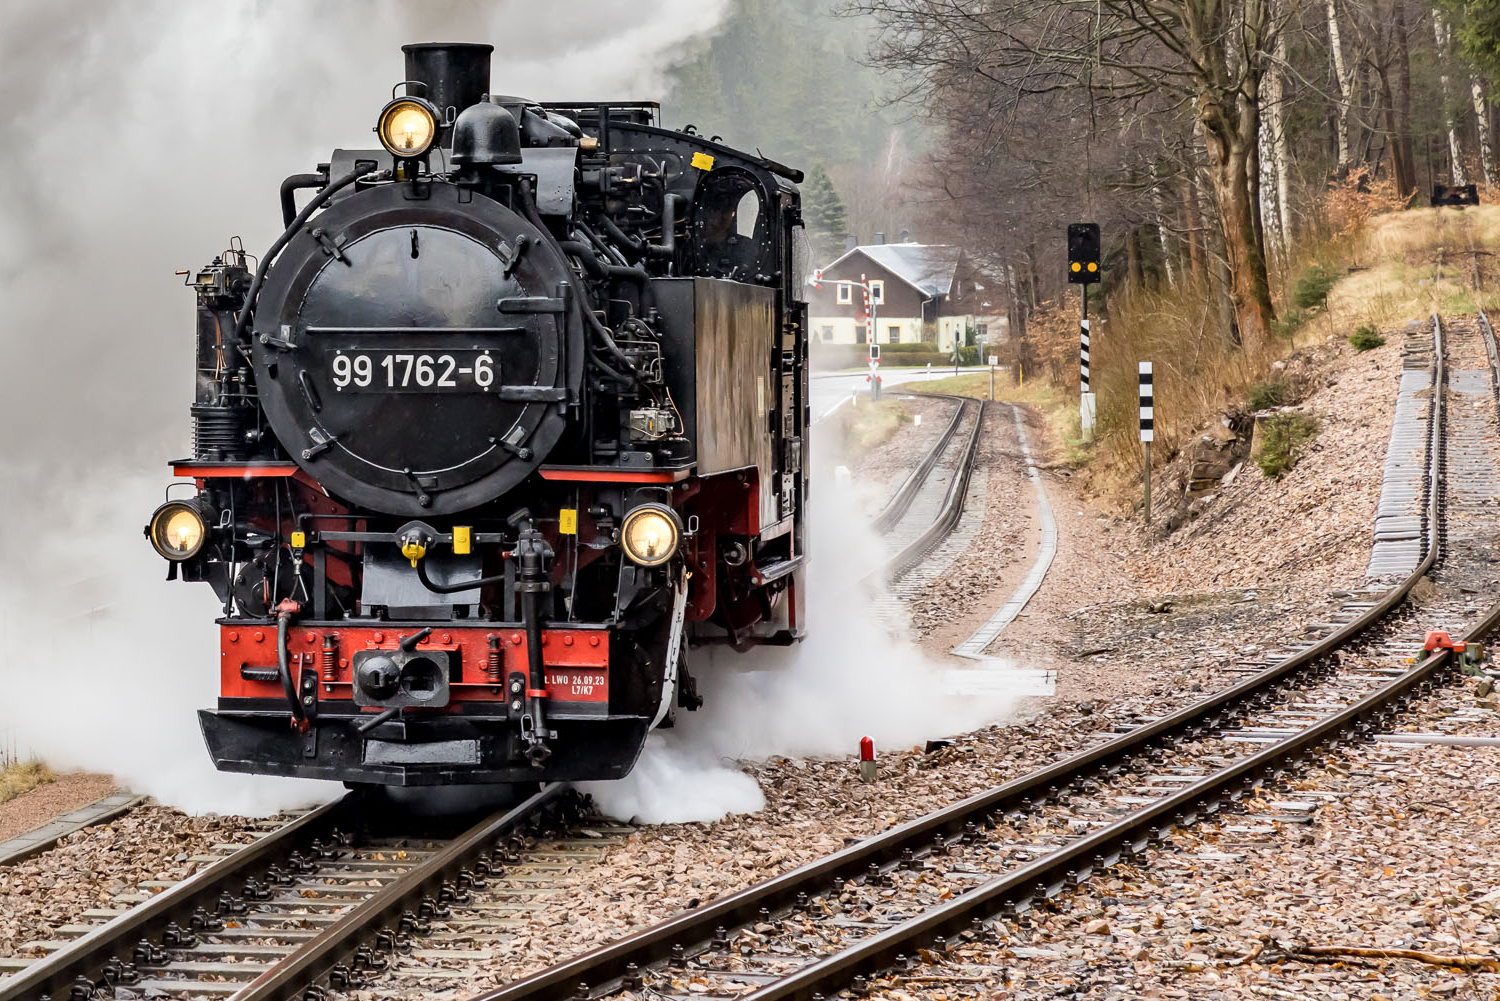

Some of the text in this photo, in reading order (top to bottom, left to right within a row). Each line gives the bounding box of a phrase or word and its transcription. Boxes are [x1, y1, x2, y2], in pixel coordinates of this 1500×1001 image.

[332, 354, 494, 387] 99 1762-6
[572, 675, 605, 686] 26.09.23
[571, 685, 594, 695] L7/K7
